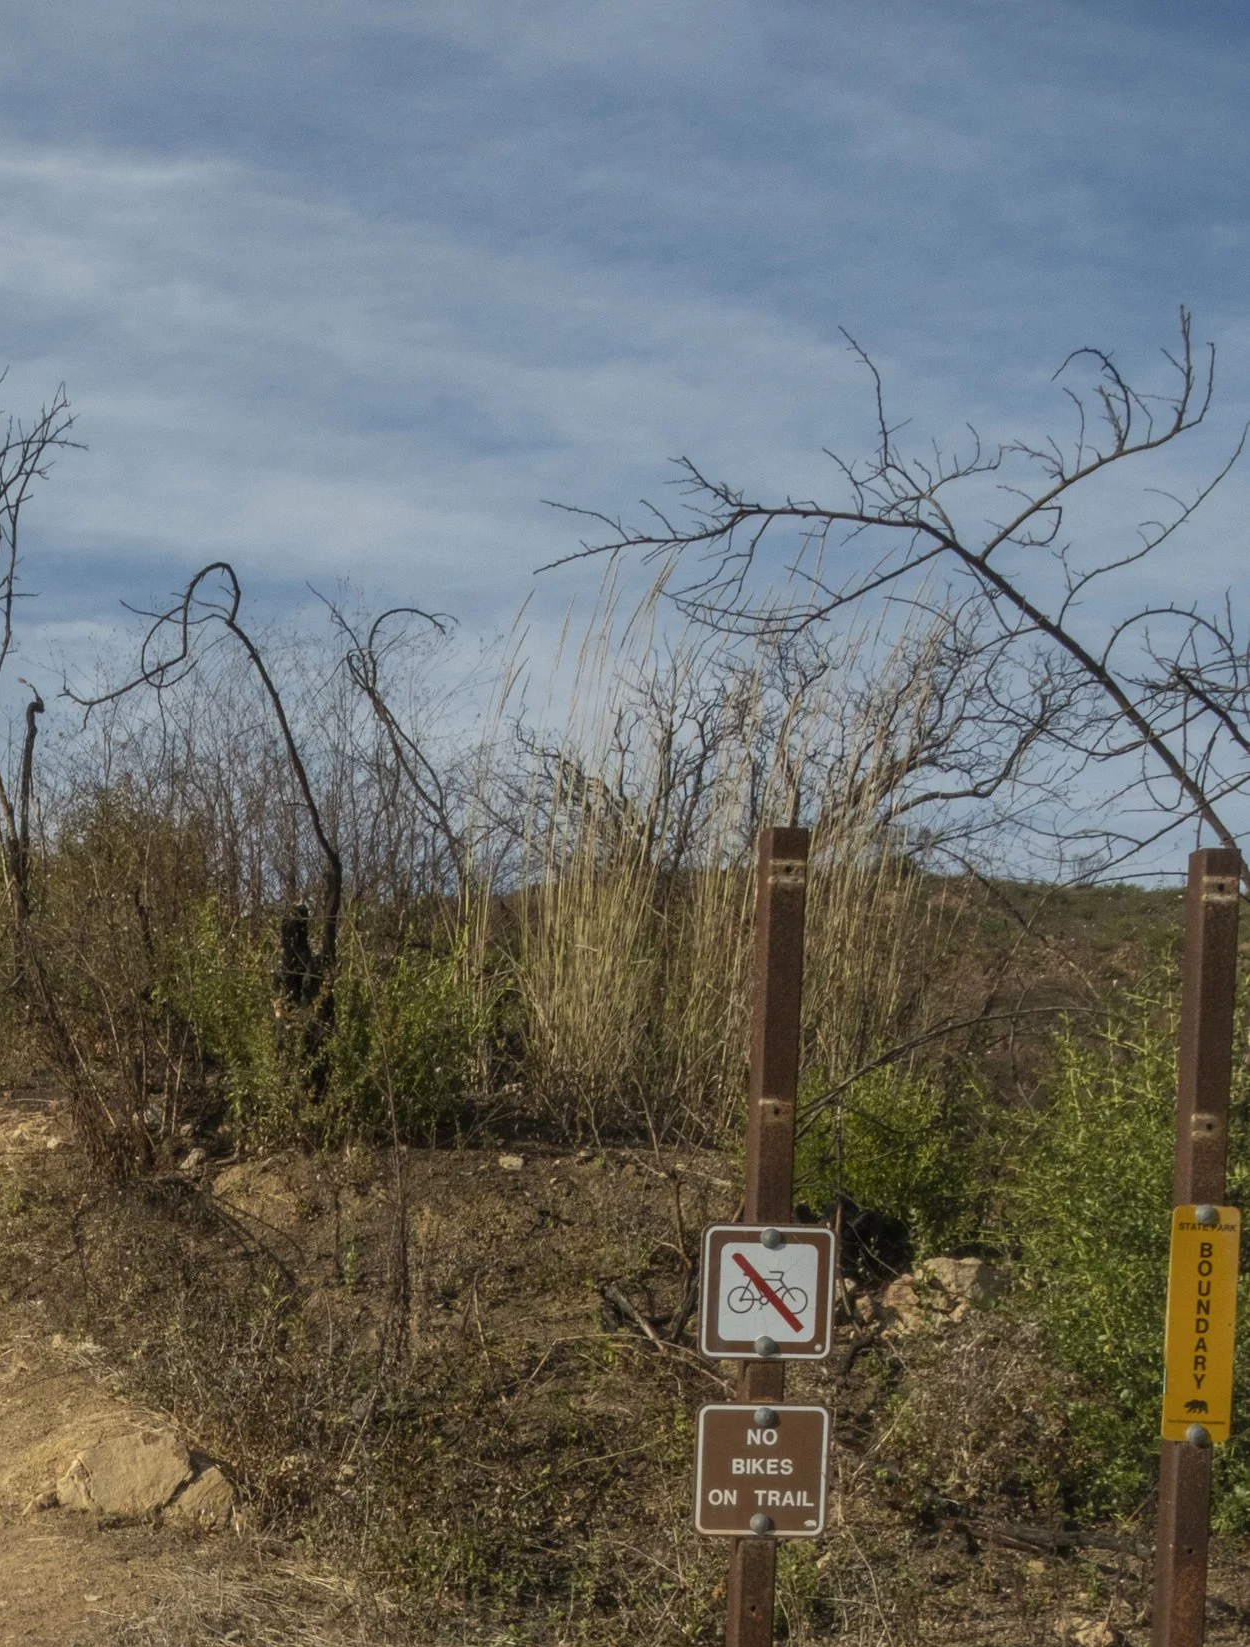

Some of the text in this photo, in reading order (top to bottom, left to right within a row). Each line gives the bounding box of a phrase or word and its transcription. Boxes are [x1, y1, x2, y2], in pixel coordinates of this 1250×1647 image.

[1178, 1222, 1209, 1231] STATE
[1193, 1242, 1213, 1389] BOUNDARY
[746, 1428, 778, 1446] NO
[731, 1458, 794, 1475] BIKES
[708, 1489, 815, 1507] ON TRAIL
